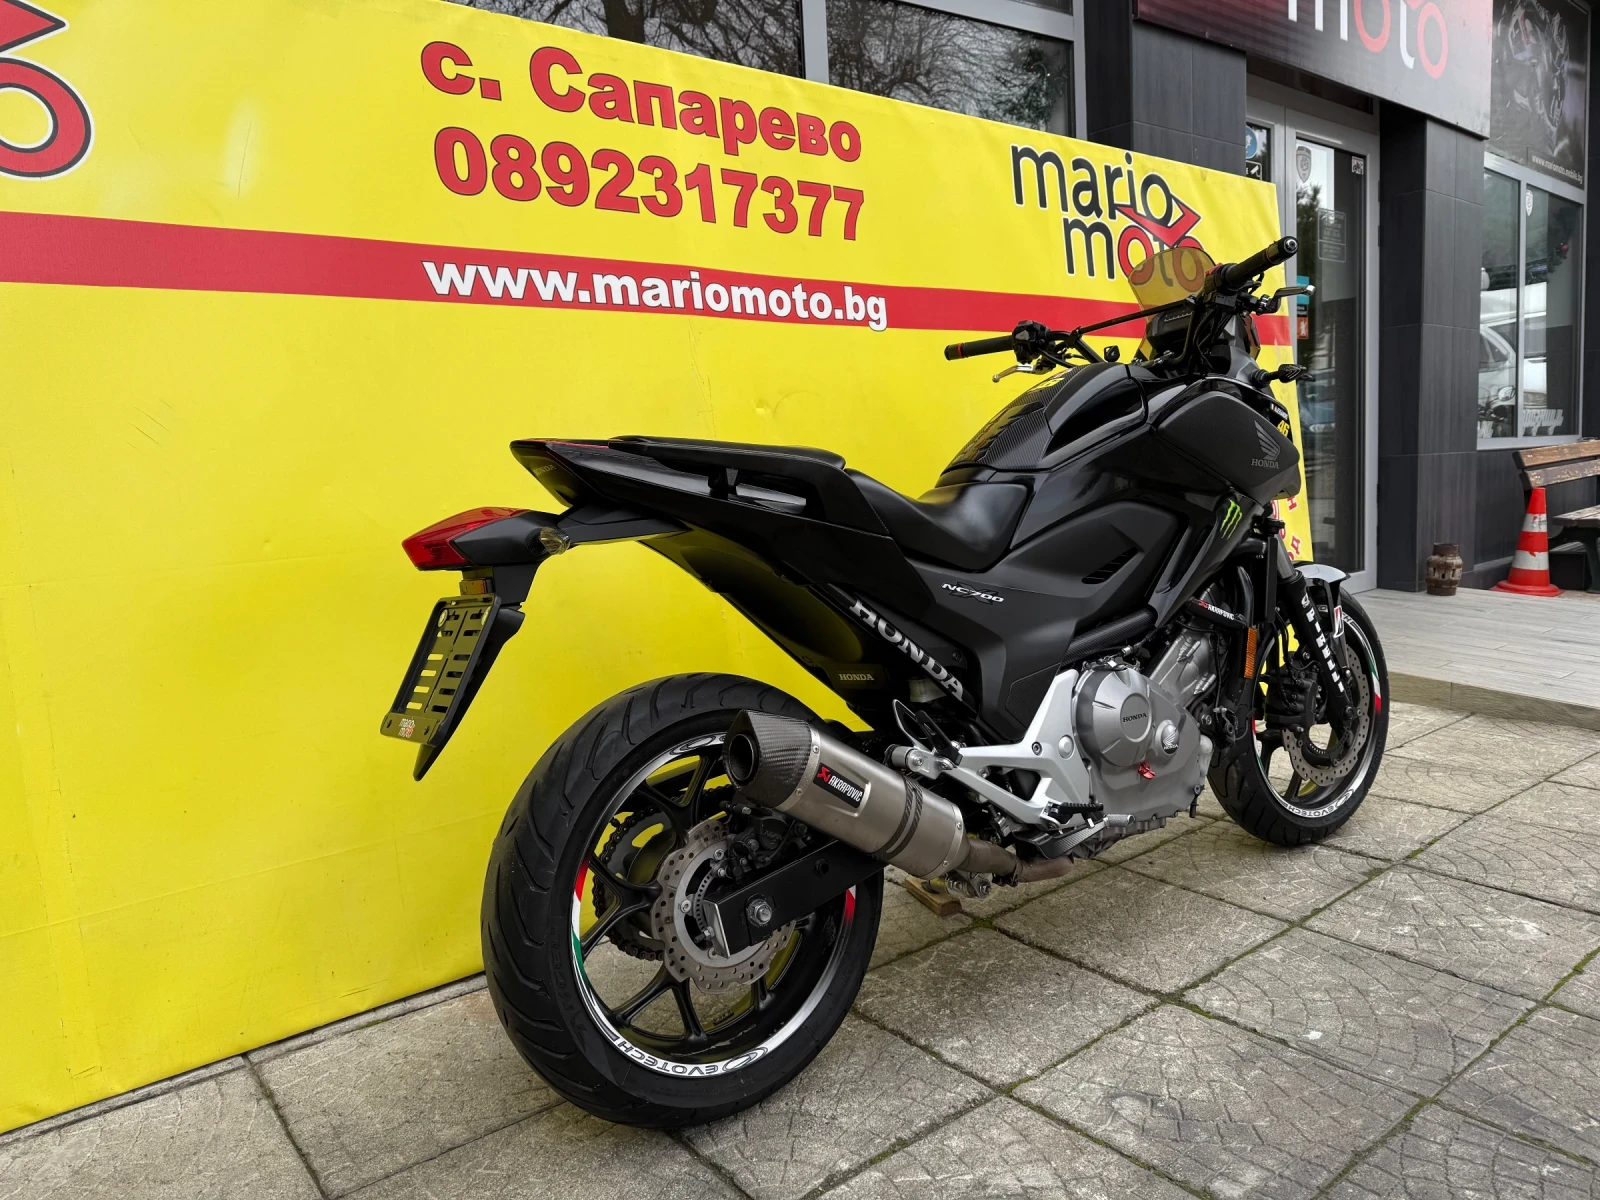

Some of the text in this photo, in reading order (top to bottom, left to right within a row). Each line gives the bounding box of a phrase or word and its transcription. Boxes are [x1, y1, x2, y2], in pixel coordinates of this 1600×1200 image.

[420, 41, 863, 163] с. Сапарево
[434, 126, 865, 241] 0892317377
[1011, 144, 1174, 229] mario
[1062, 217, 1206, 293] moto
[422, 260, 888, 332] www.mariomoto.bg
[1251, 458, 1280, 469] HONDA
[941, 583, 1005, 603] NC700
[838, 672, 875, 682] HONDA
[849, 599, 963, 701] HONDA
[1122, 713, 1148, 723] HONDA
[1288, 805, 1335, 817] EVOTECH
[618, 1040, 718, 1076] EVOTECH
